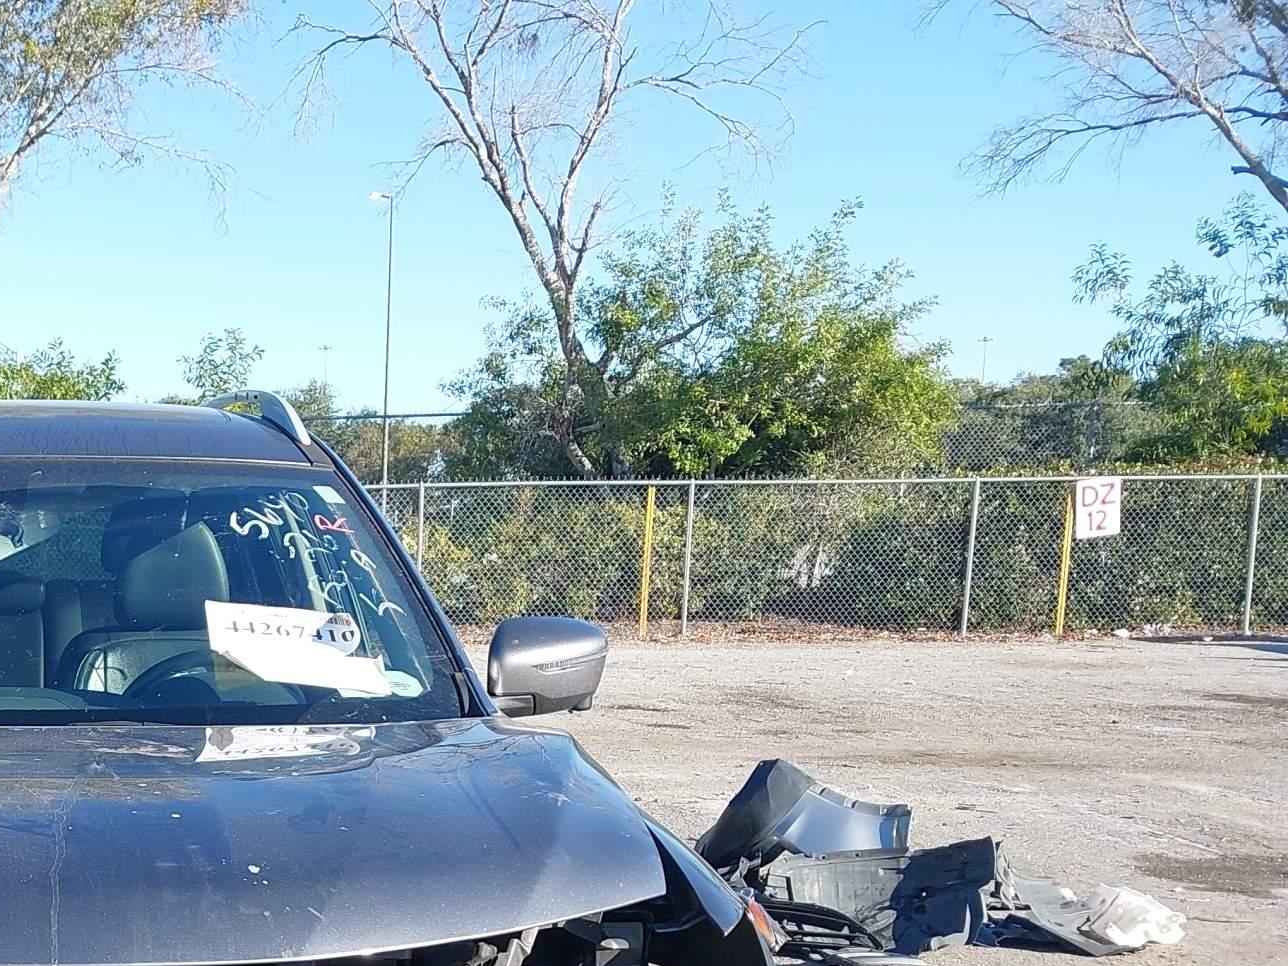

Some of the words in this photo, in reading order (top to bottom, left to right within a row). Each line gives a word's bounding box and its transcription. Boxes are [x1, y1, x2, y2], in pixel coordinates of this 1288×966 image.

[1082, 483, 1115, 507] DZ
[1088, 510, 1107, 531] 12
[224, 621, 356, 643] 44267410
